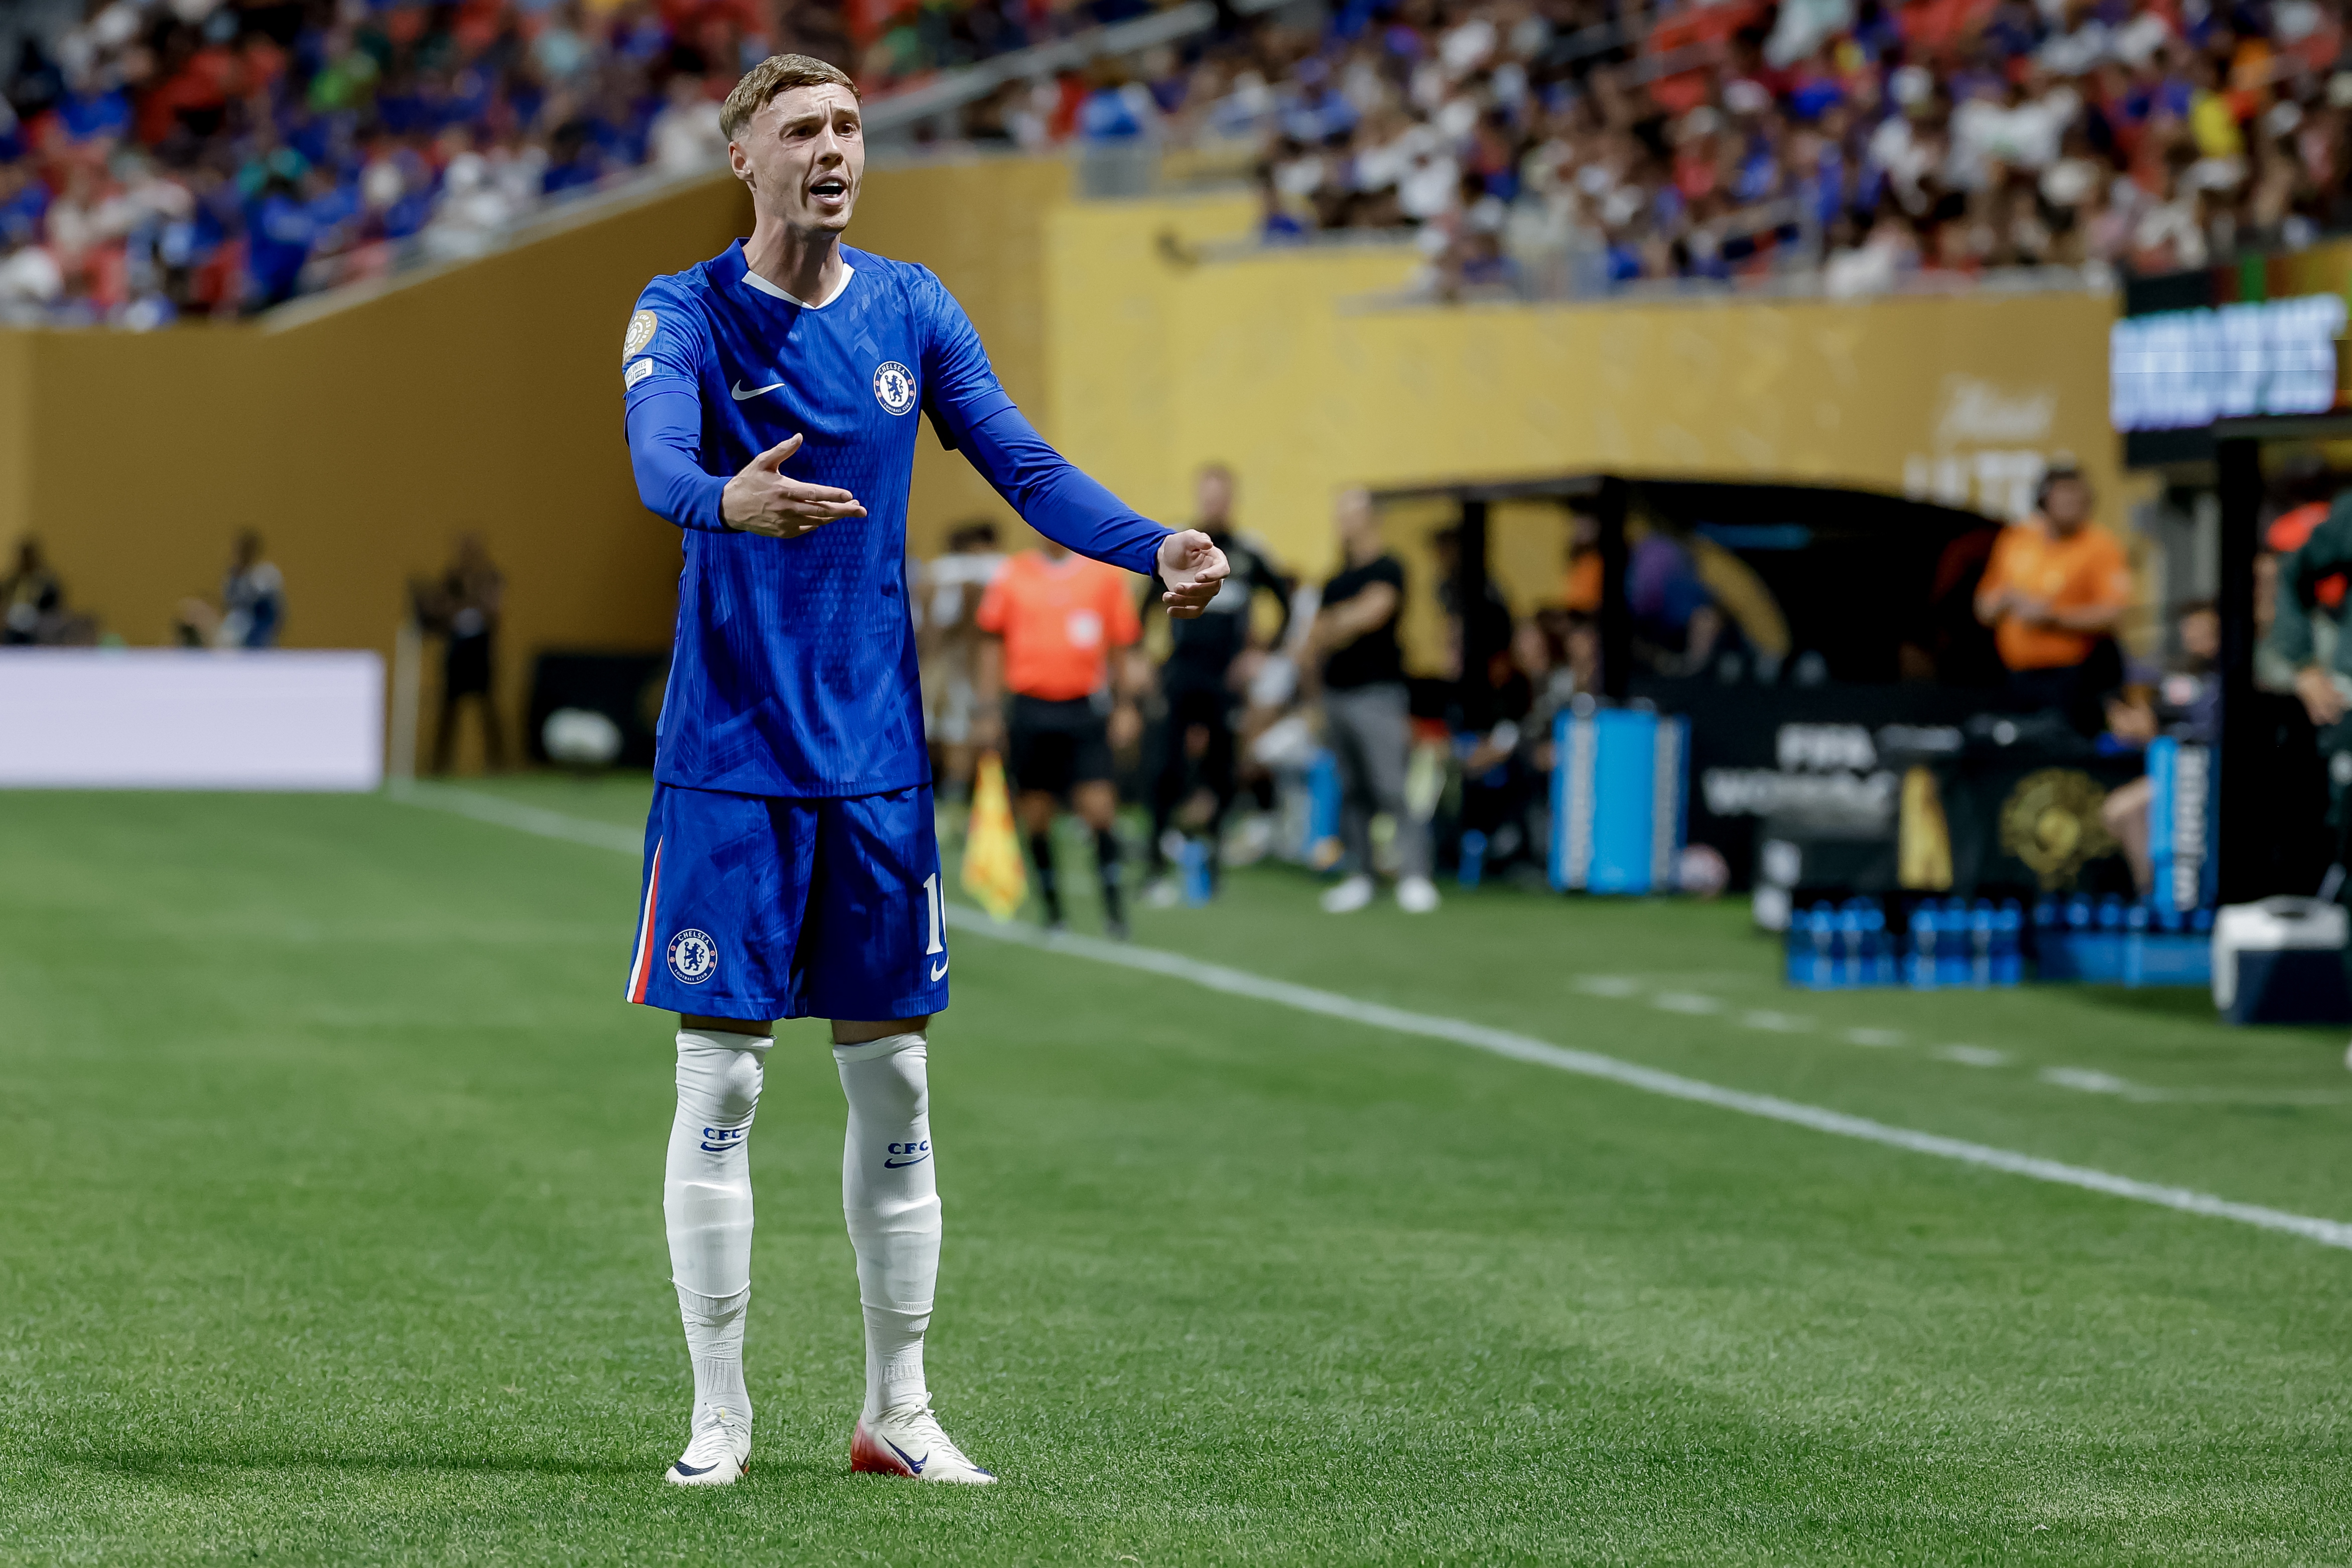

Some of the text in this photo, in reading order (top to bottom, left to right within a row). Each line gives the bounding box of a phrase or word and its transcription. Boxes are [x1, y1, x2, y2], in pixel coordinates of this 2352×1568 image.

[637, 329, 650, 343] USA
[623, 346, 636, 361] FIFA
[632, 361, 646, 372] UNITES
[878, 363, 905, 375] CHELSEA
[883, 402, 910, 413] FOOTBALL CLUB
[923, 872, 947, 955] 1
[678, 931, 709, 945] CHELSEA
[674, 969, 708, 981] FOOTBALL CLUB
[703, 1127, 741, 1141] CFC
[887, 1139, 929, 1155] CFC
